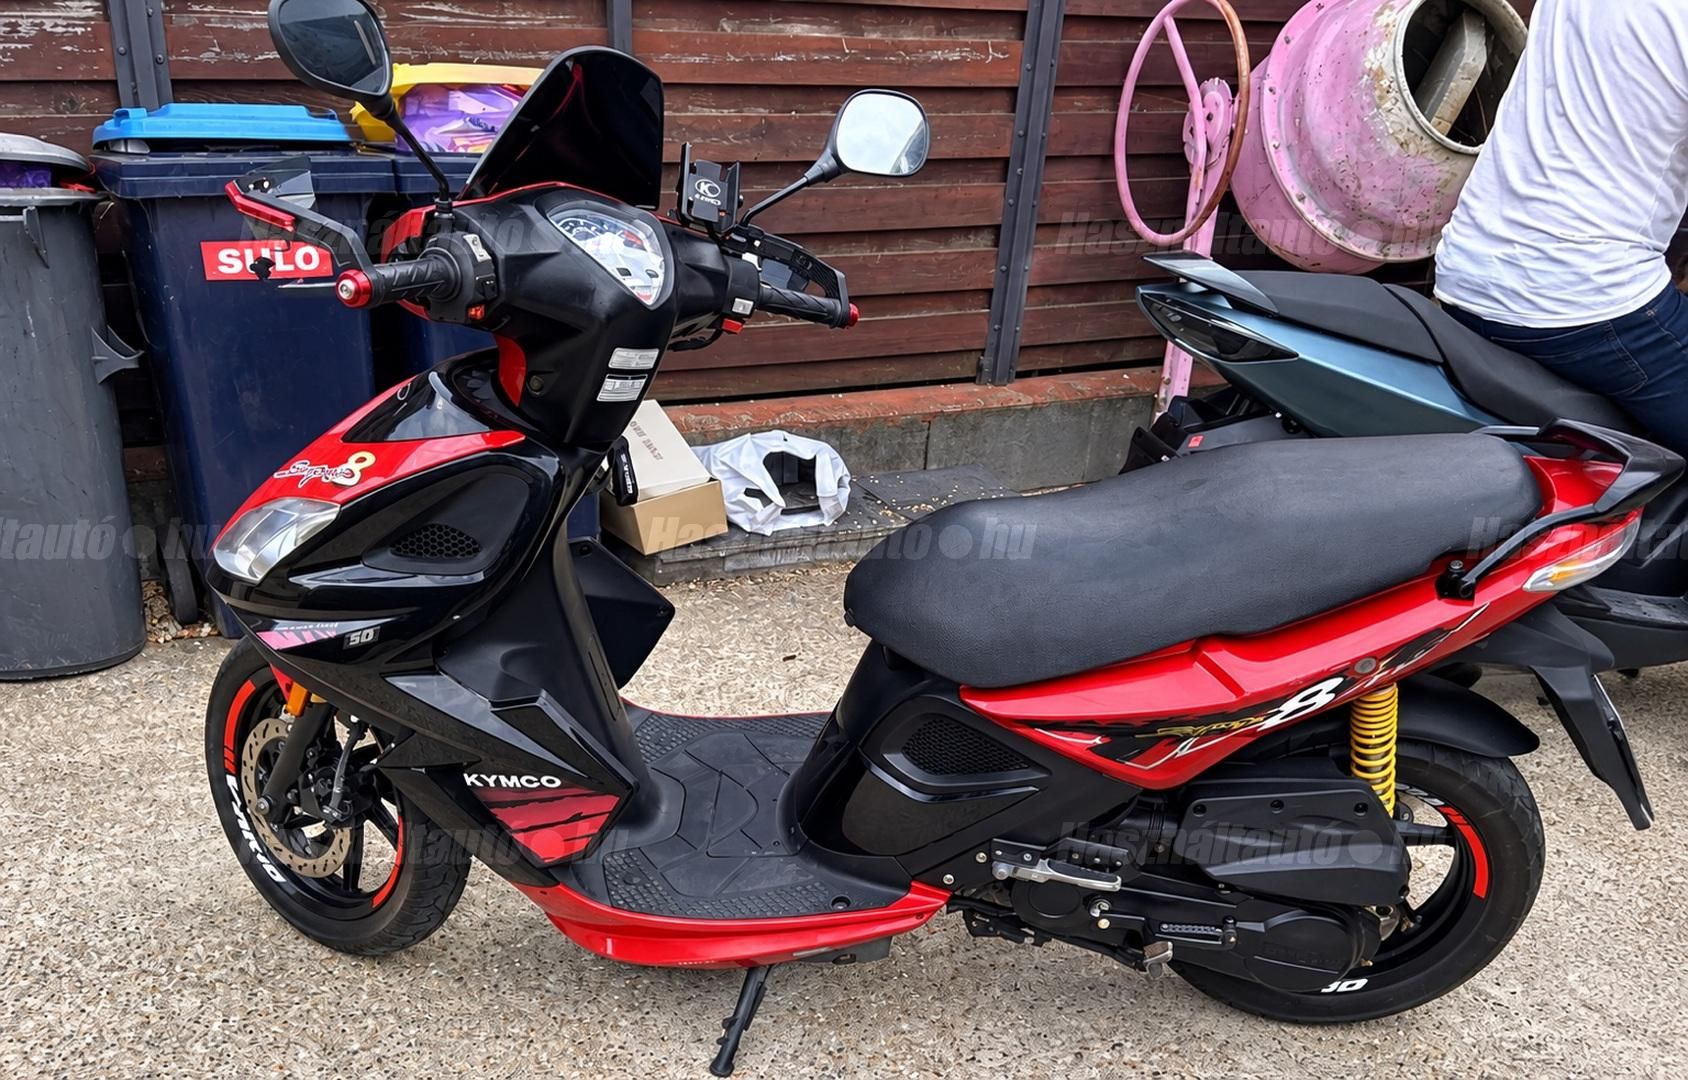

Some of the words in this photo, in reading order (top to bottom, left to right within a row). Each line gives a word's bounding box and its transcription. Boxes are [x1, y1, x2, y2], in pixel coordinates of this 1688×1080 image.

[217, 245, 320, 274] SULO
[349, 628, 375, 645] 50
[463, 773, 562, 788] KYMCO
